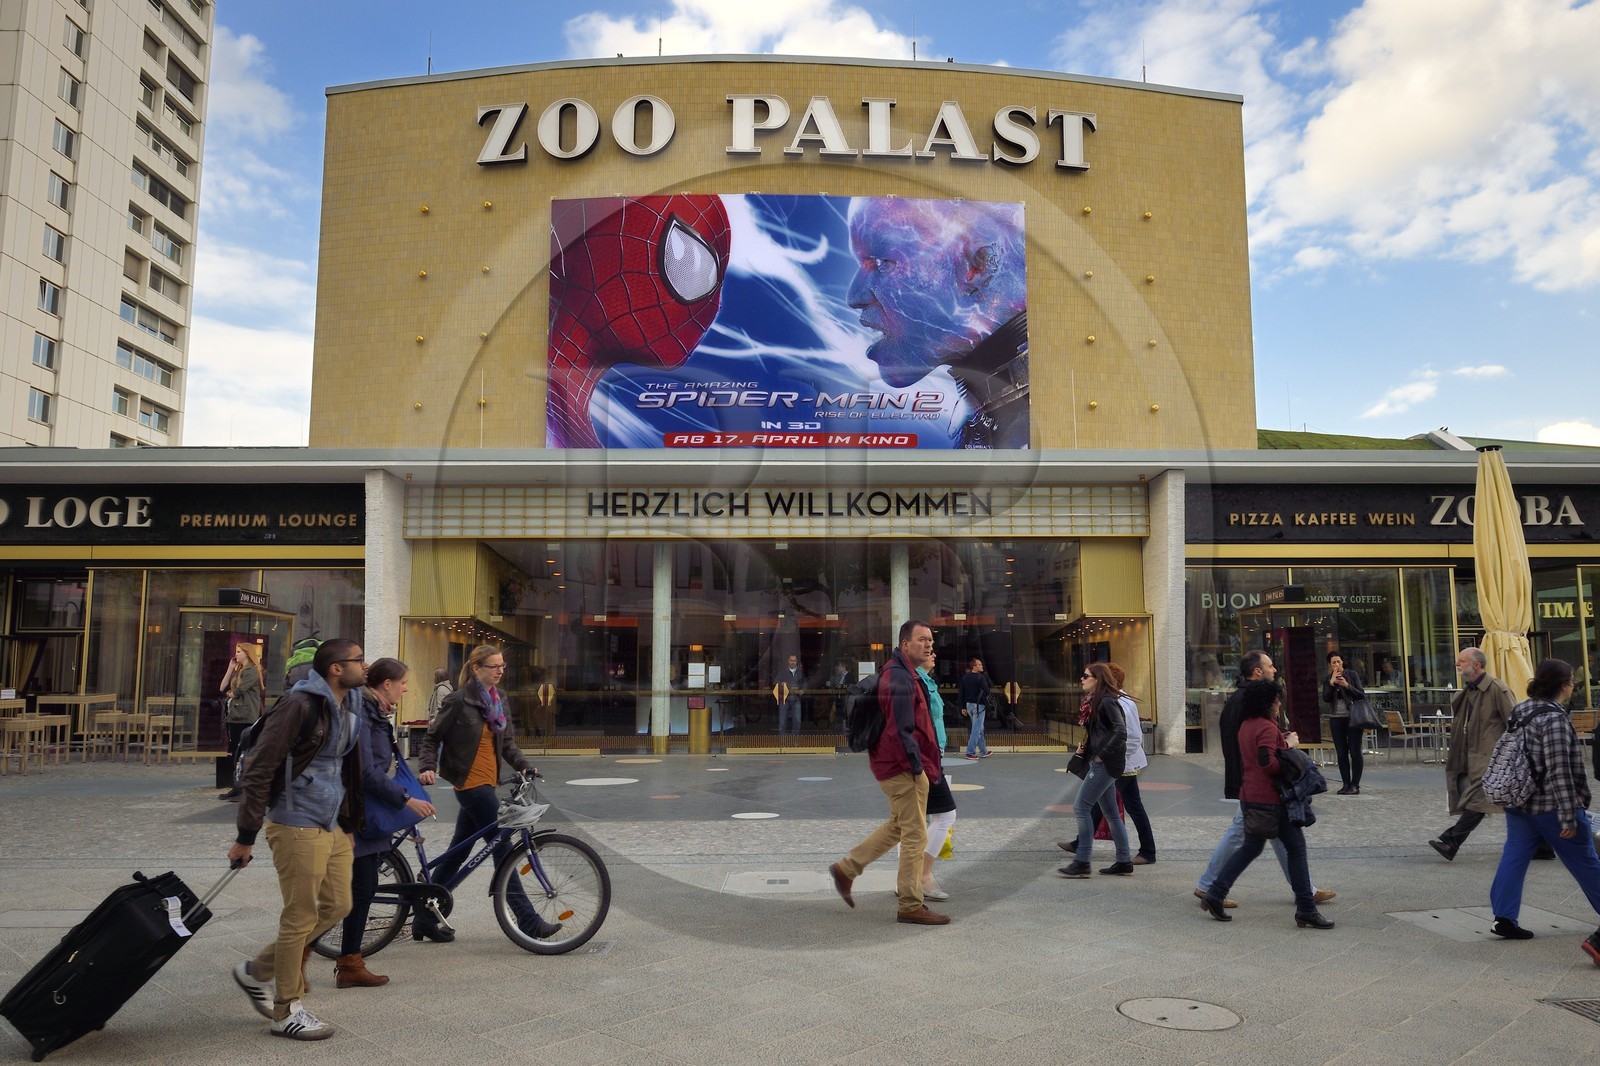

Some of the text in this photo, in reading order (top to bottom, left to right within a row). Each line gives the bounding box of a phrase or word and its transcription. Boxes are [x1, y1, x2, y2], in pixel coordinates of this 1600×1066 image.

[476, 93, 1097, 171] ZOO PALAST
[646, 381, 758, 390] THE AMAZING
[636, 391, 945, 412] SPIDER-MAN 2
[849, 411, 868, 419] OF
[871, 412, 940, 420] ELECTRO
[761, 420, 821, 430] IN 3D
[673, 435, 909, 445] AB 17. APRIL IM KINO
[588, 491, 992, 517] HERZLICH WILLKOMMEN
[24, 496, 152, 529] LOGE
[1229, 512, 1416, 526] PIZZA KAFFEE WEIN
[180, 513, 357, 527] PREMIUM LOUNGE
[1201, 593, 1260, 609] BUON
[1349, 595, 1382, 604] COFFEE
[468, 835, 502, 868] CONWAY
